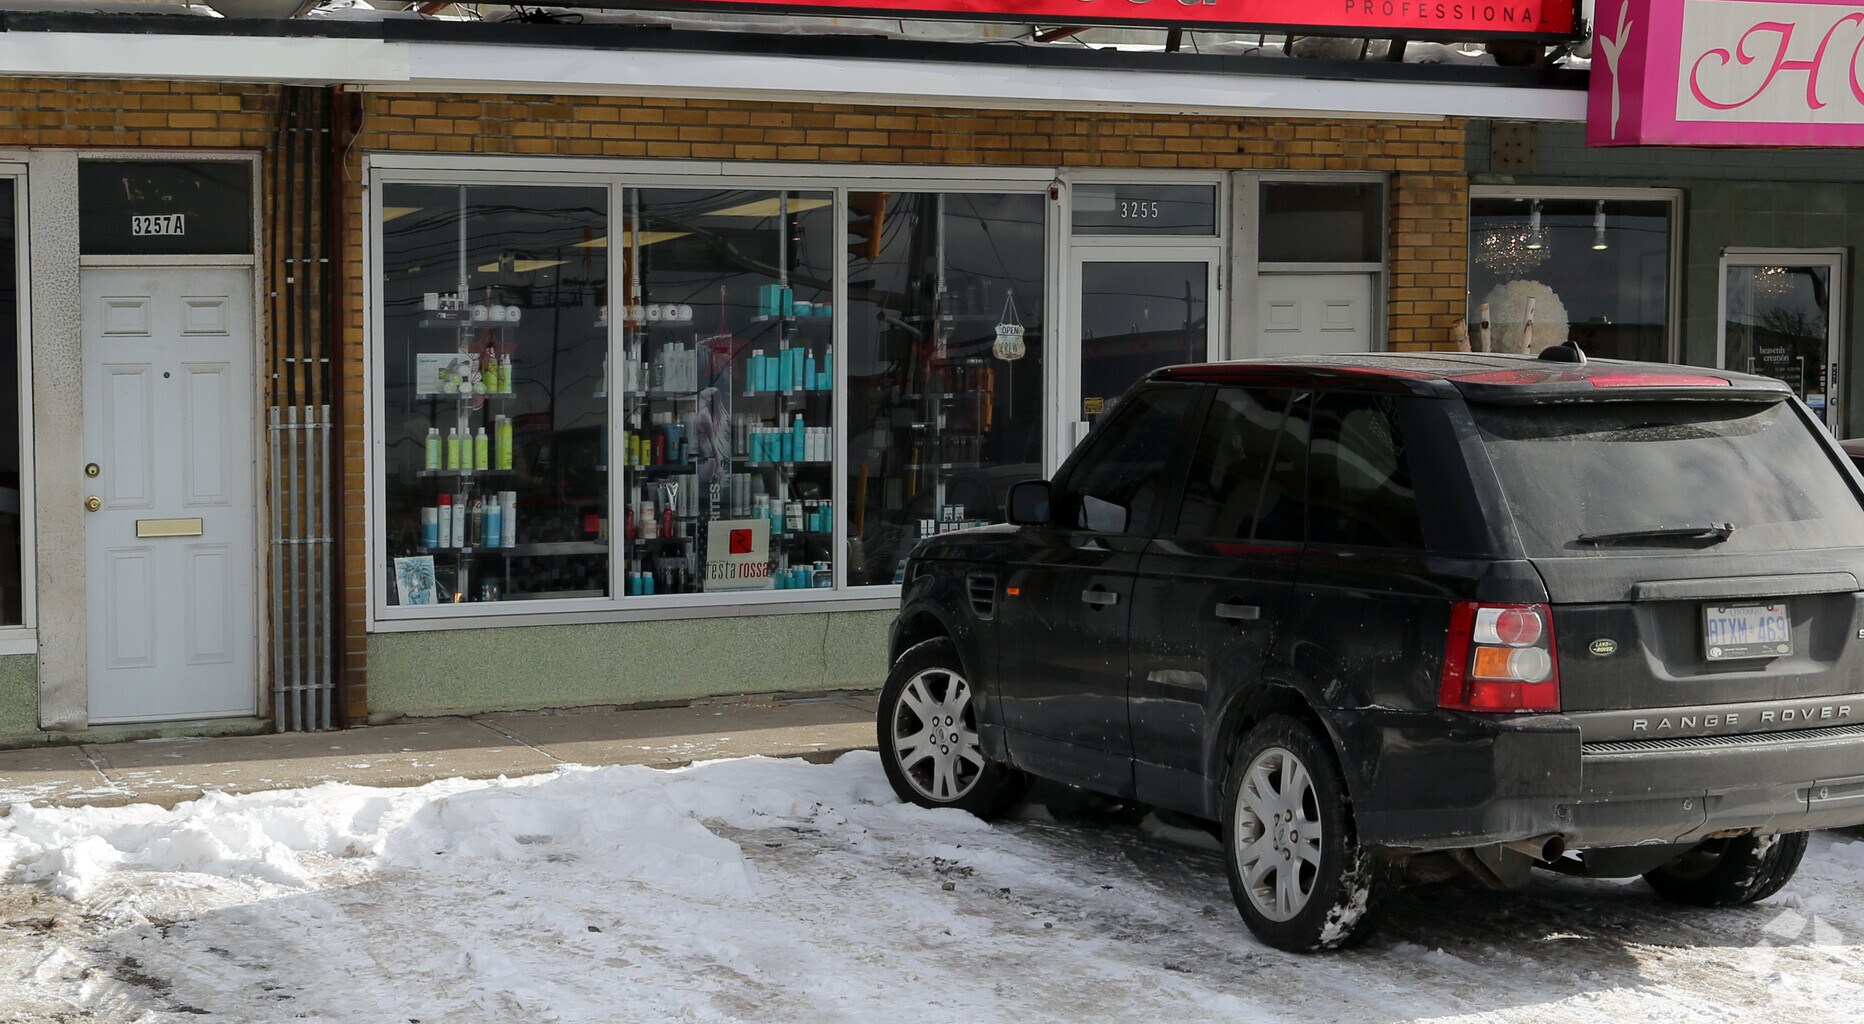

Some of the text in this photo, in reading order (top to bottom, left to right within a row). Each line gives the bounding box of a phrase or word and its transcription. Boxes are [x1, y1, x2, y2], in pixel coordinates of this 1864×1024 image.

[1345, 0, 1549, 24] PROFESSIONAL
[1120, 201, 1159, 219] 3255
[133, 215, 184, 234] 3257A
[1001, 326, 1019, 335] OPEN
[1759, 346, 1786, 355] heavenly
[739, 562, 769, 578] rossa
[1730, 607, 1762, 616] ONTARIO
[1632, 705, 1851, 732] RANGE ROVER
